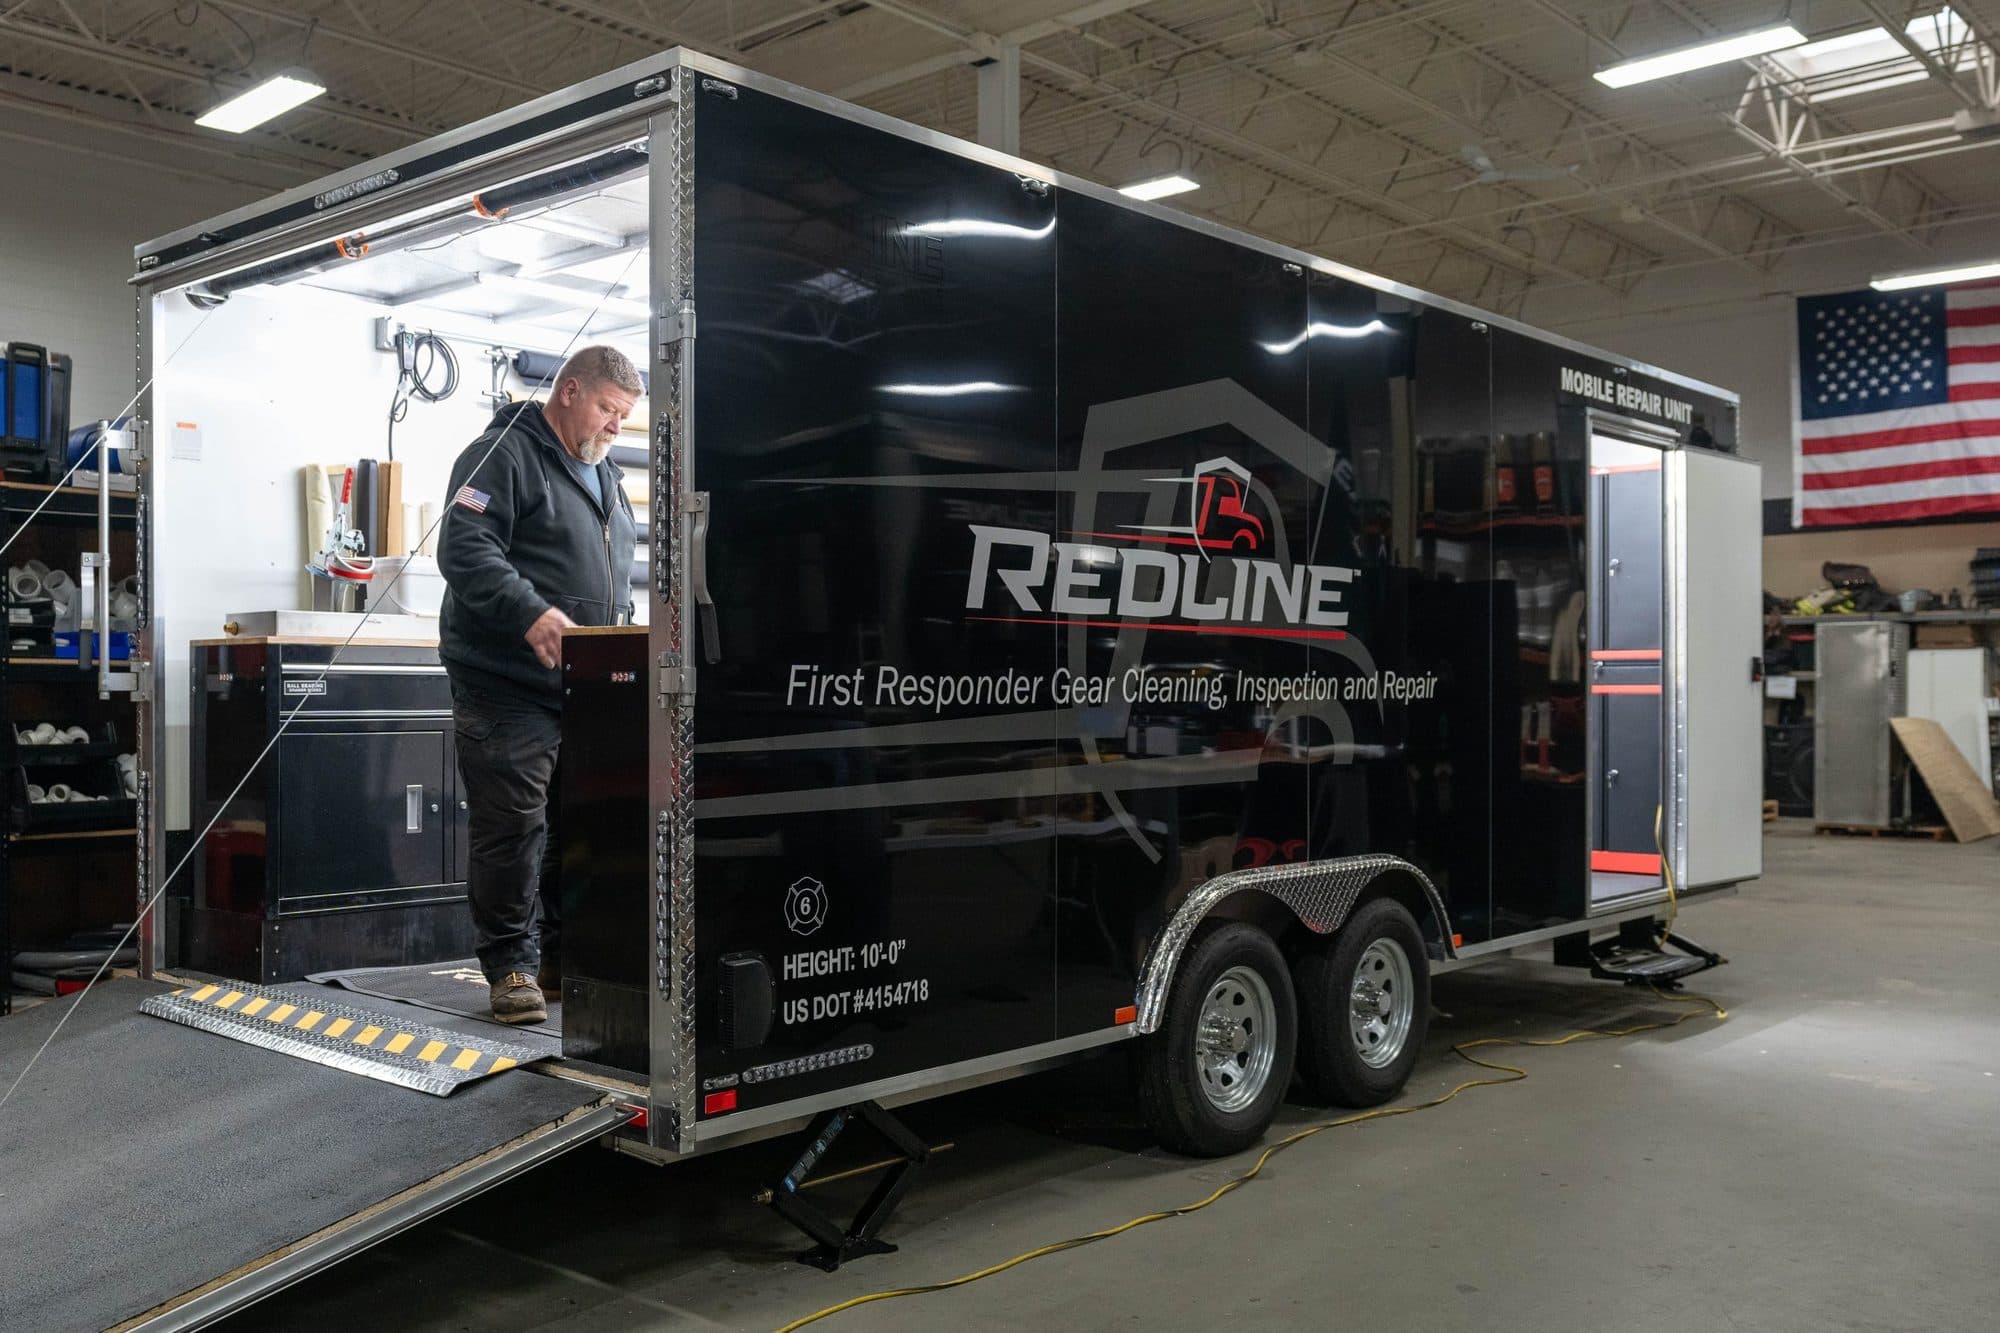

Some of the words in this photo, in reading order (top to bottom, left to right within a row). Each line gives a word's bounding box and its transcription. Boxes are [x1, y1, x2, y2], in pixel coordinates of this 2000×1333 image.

[1560, 367, 1614, 403] MOBILE
[1616, 383, 1662, 417] REPAIR
[1664, 397, 1693, 425] UNIT
[965, 524, 1353, 626] REDLINE
[787, 664, 865, 706] First
[875, 665, 1044, 714] Responder
[1051, 667, 1116, 704] Gear
[1122, 668, 1228, 711] Cleaning,
[1235, 670, 1339, 708] Inspection
[1343, 670, 1378, 701] and
[1383, 670, 1438, 706] Repair
[800, 896, 811, 915] 6
[783, 946, 856, 981] HEIGHT:
[783, 999, 809, 1025] US
[813, 992, 851, 1020] DOT
[853, 979, 929, 1014] #4154718
